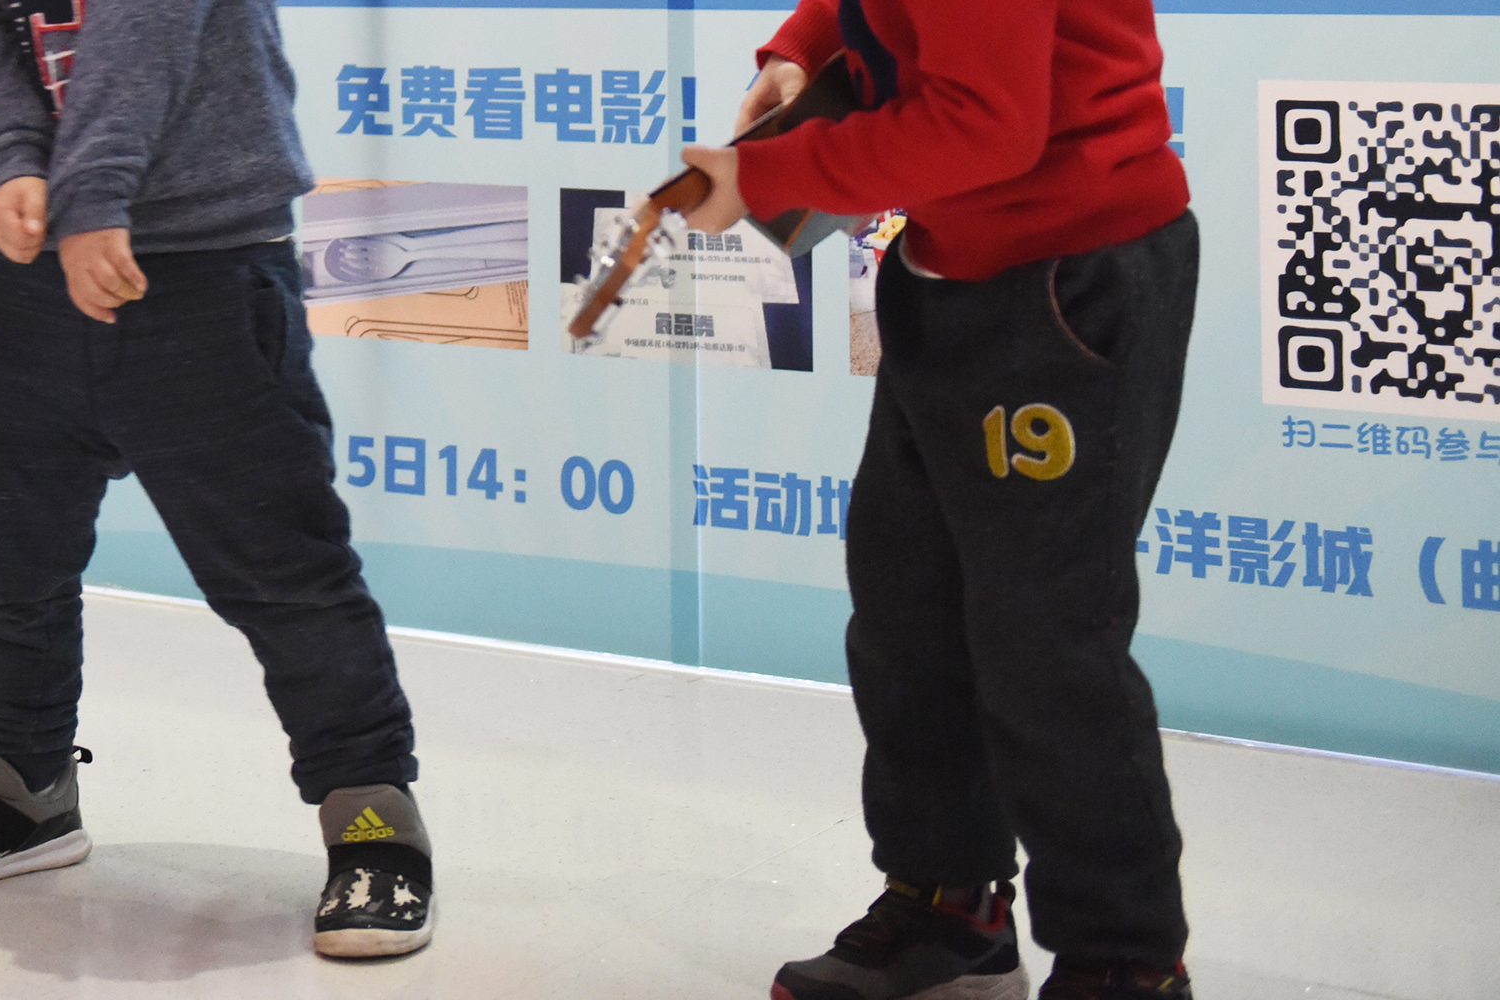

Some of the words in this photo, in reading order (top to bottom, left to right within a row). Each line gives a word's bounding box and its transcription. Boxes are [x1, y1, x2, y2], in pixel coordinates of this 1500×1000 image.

[335, 64, 697, 145] 免费看电影！
[982, 404, 1076, 481] 19
[341, 826, 395, 842] adidas
